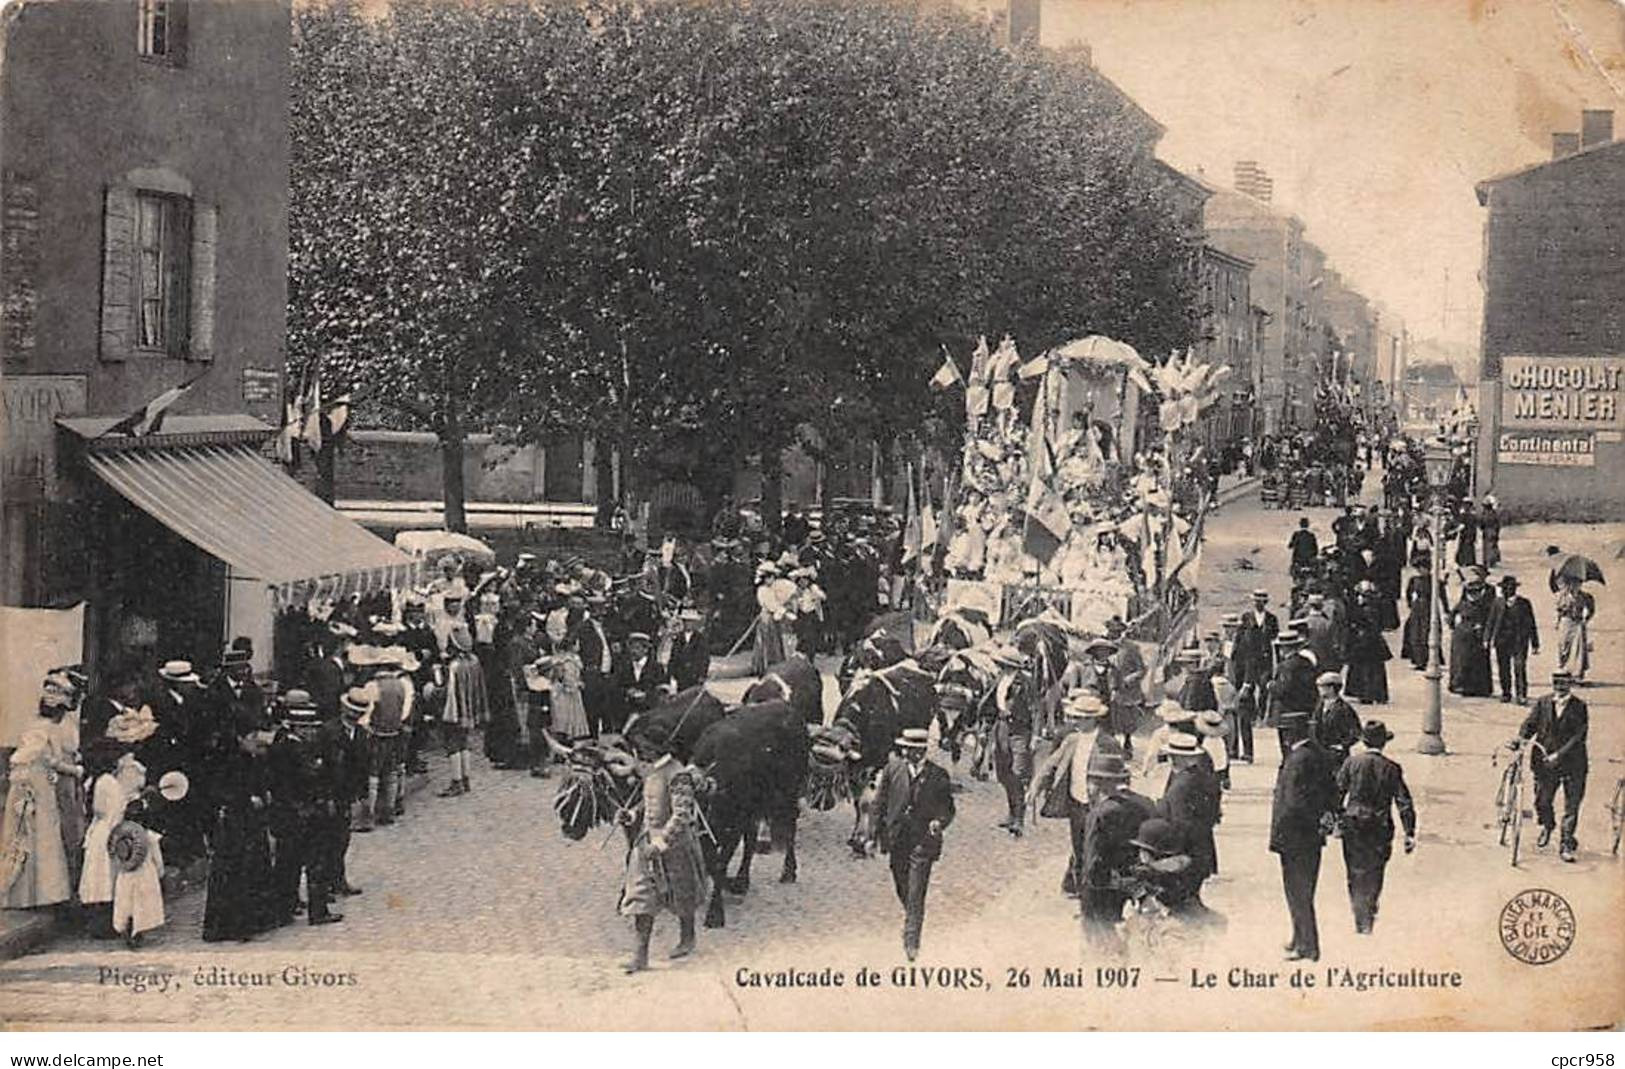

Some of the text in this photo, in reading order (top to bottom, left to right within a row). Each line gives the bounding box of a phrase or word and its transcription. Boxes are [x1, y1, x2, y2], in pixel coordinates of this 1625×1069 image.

[1509, 365, 1621, 391] CHOCOLAT
[1514, 392, 1616, 420] MENIER
[1499, 432, 1595, 453] Continental
